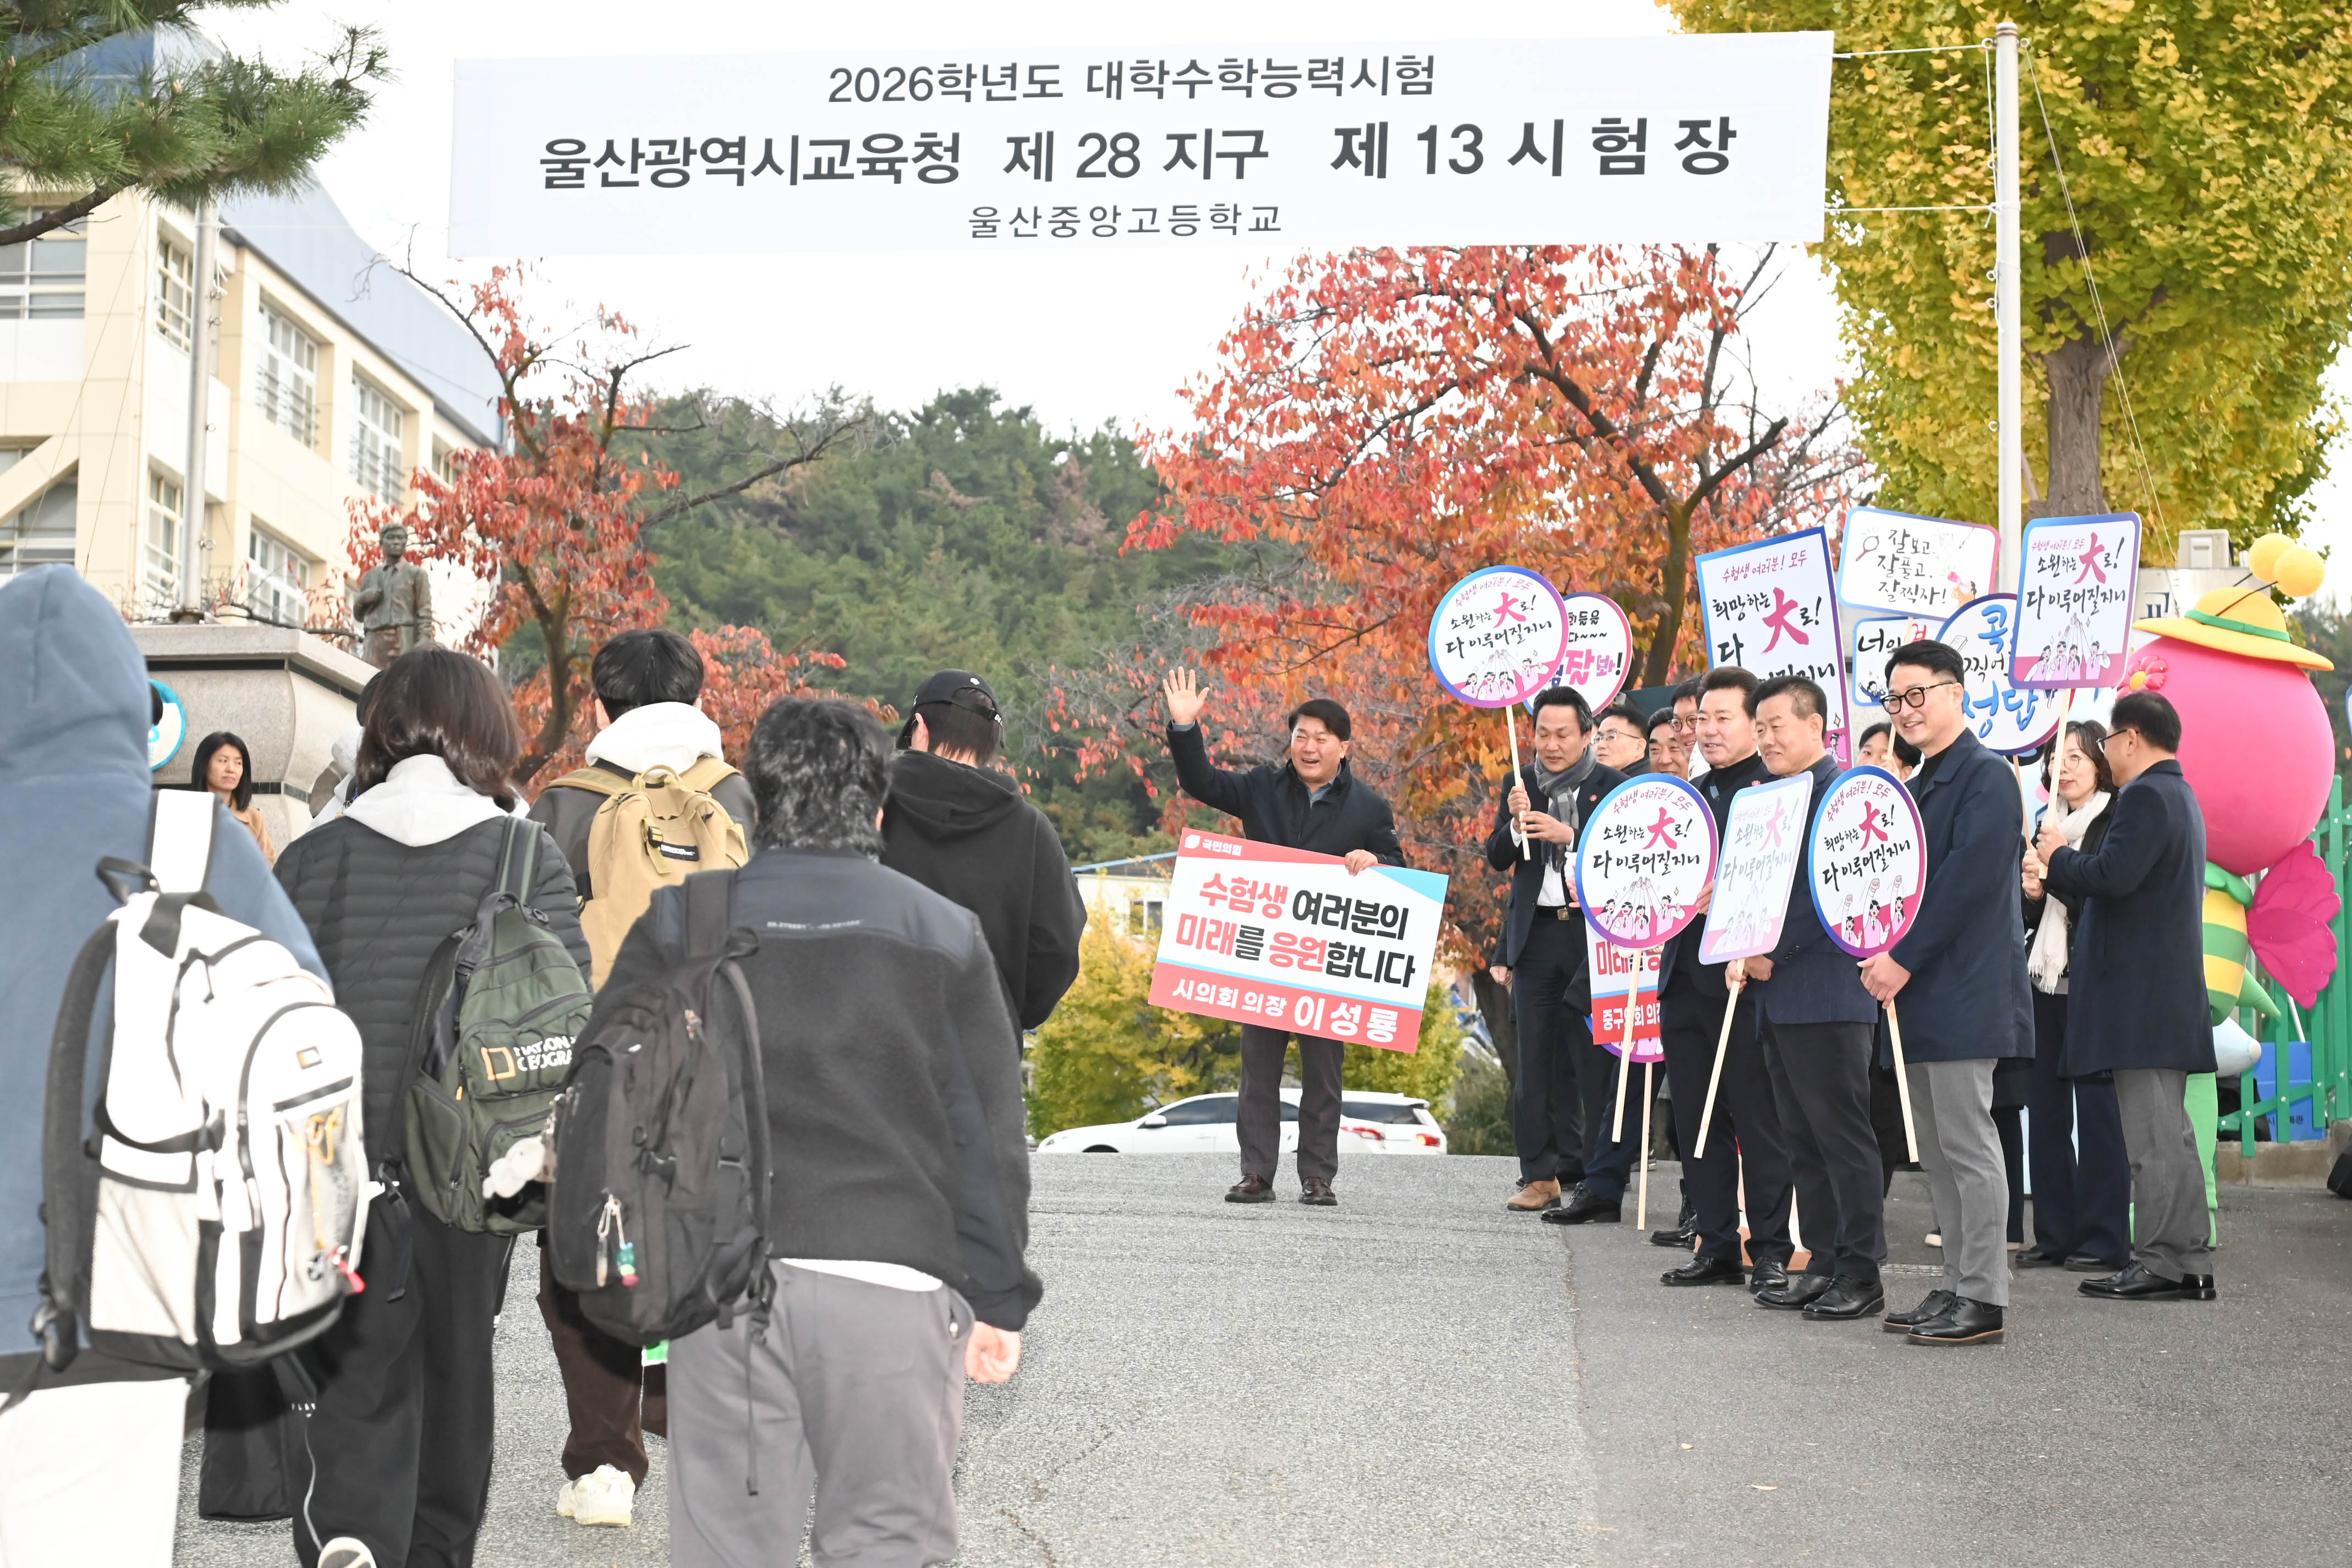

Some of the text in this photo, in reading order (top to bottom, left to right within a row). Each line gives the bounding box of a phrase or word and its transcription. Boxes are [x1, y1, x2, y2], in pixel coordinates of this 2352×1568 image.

[829, 54, 1435, 103] 2026학년도 대학수학능력시험
[539, 132, 960, 189] 울산광역시교육청
[1002, 130, 1054, 182] 제
[1077, 131, 1141, 178] 28
[1163, 128, 1268, 180] 지구
[1330, 122, 1388, 178] 제
[1416, 124, 1484, 174] 13
[968, 204, 1281, 238] 울산중앙고등학교
[1723, 562, 1750, 583] 수험생
[1789, 550, 1807, 568] 모두
[2037, 554, 2077, 578] 소원하는
[1456, 583, 1477, 607] 수험생
[1512, 579, 1533, 590] 모두
[1712, 592, 1770, 621] 희망하는
[1451, 612, 1492, 629] 소원하는
[1470, 621, 1551, 648] 이루어질지니
[1614, 790, 1638, 814] 수험생
[1671, 796, 1693, 810] 모두
[1828, 790, 1844, 821] 수험생
[1873, 783, 1891, 798] 모두
[1202, 838, 1242, 856] 국민의힘
[1604, 824, 1644, 844] 소원하는
[1824, 828, 1859, 852] 희망하는
[1593, 850, 1699, 879] 다 이루어질지니
[1823, 840, 1910, 892] 다 이루어질지니
[1199, 873, 1409, 940] 수험생 여러분의
[1175, 913, 1415, 988] 미래를 응원합니다
[1172, 978, 1238, 1008] 시의회
[1242, 991, 1286, 1017] 의장
[1603, 1005, 1644, 1030] 중구회
[513, 1035, 577, 1056] NATION
